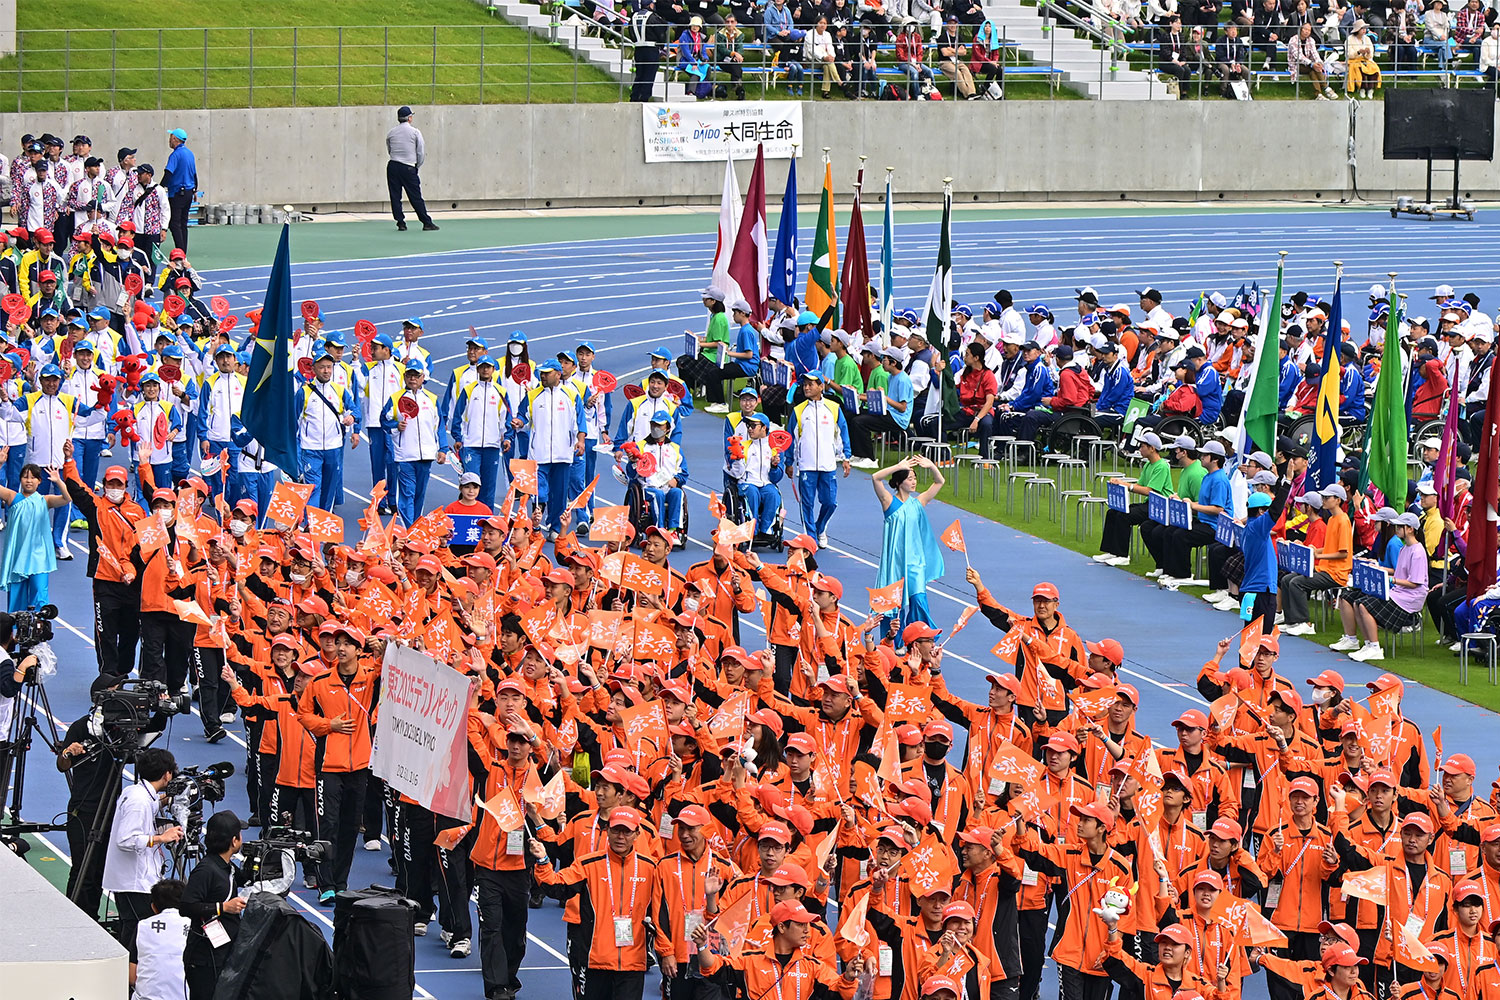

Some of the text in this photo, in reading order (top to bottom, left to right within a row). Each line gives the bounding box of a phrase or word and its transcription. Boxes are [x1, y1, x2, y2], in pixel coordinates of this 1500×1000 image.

[694, 128, 720, 140] DAIDO
[723, 120, 793, 142] 大同生命
[308, 512, 341, 536] 東京
[623, 561, 663, 587] 東京
[95, 602, 103, 632] TOKYO
[636, 629, 672, 654] 東京
[194, 647, 204, 678] TOKYO
[888, 690, 926, 714] 東京
[271, 788, 279, 822] TOKYO
